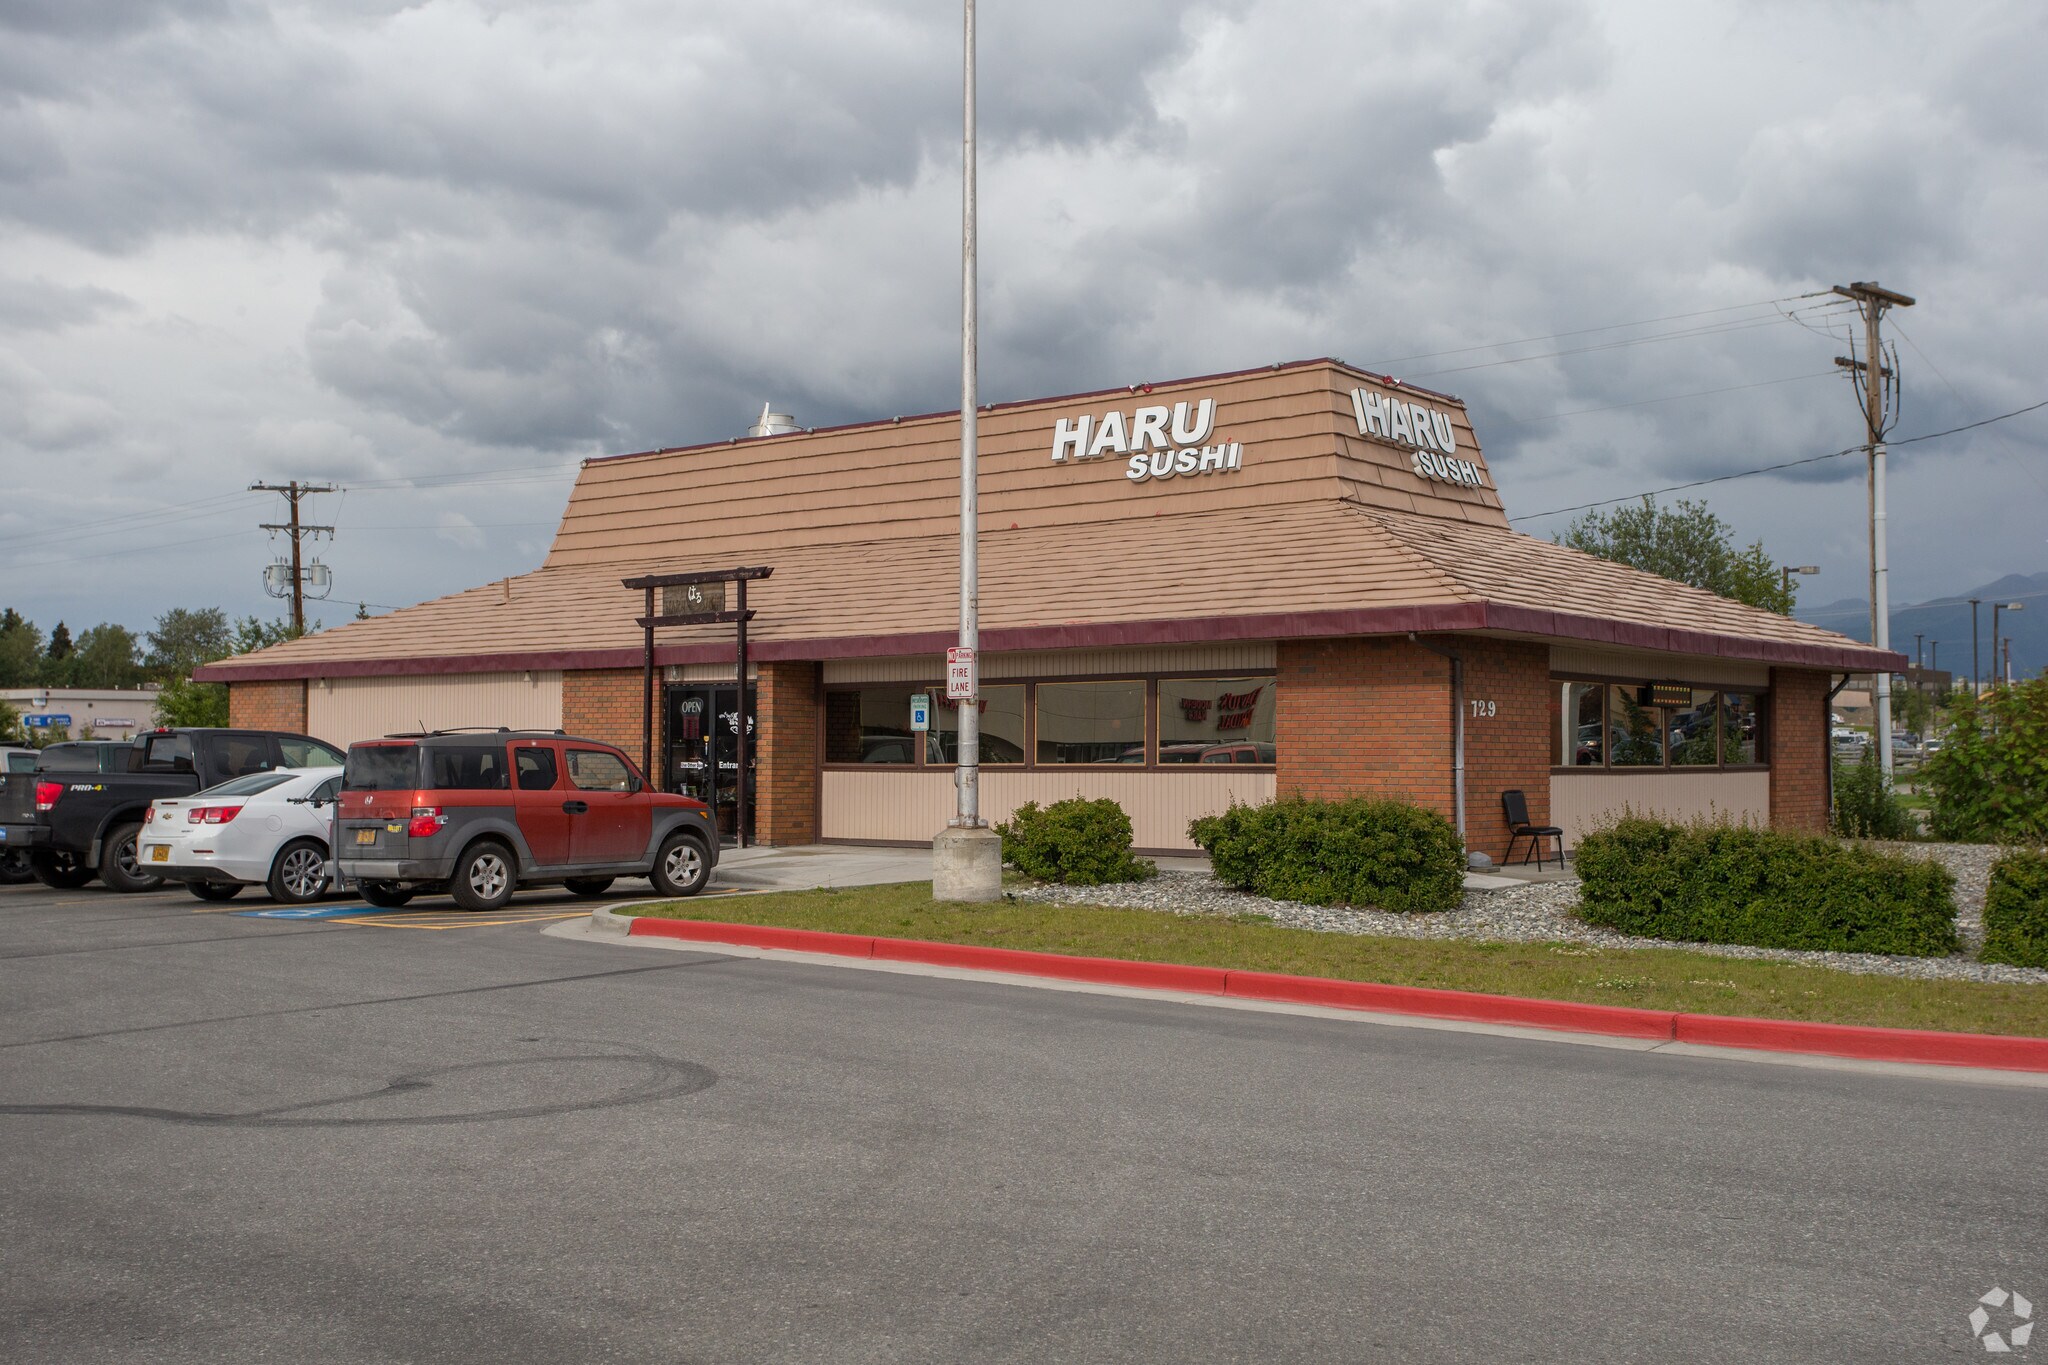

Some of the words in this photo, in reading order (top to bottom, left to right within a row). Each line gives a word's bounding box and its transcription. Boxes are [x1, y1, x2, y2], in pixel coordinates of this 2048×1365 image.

[1357, 387, 1456, 454] HARU
[1051, 398, 1214, 462] HARU
[1126, 442, 1242, 480] SUSHI
[1415, 450, 1483, 485] SUSHI
[948, 651, 956, 661] NO
[952, 668, 968, 678] FIRE
[951, 682, 969, 692] LANE
[681, 701, 701, 713] OPEN
[1471, 700, 1496, 717] 729
